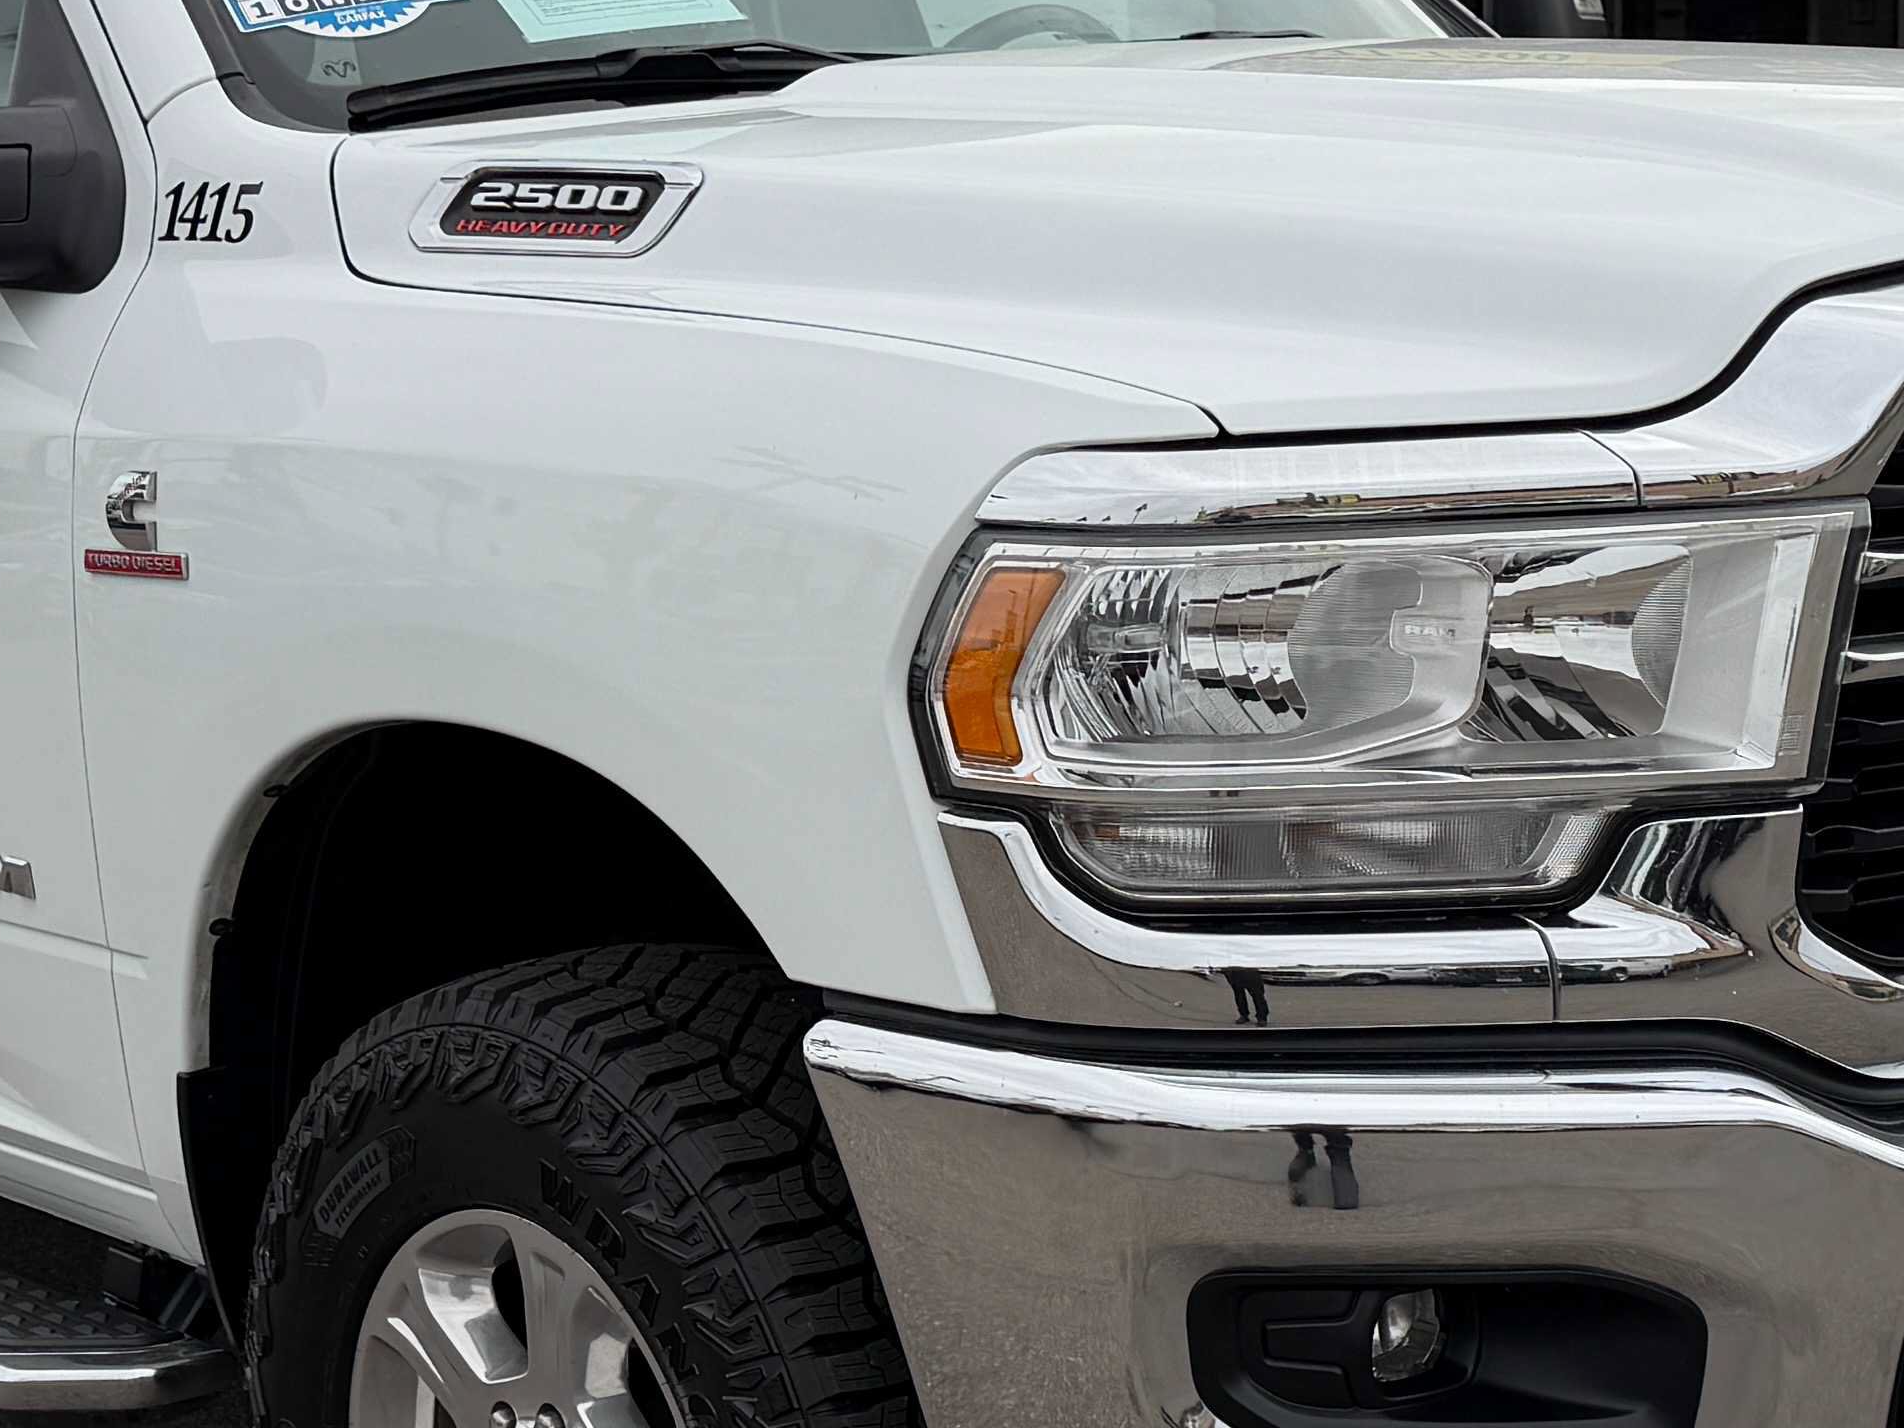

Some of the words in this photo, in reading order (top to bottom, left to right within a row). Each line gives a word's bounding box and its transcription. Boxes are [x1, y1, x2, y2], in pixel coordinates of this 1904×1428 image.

[335, 9, 387, 25] CARFAX
[470, 181, 645, 212] 2500
[157, 180, 264, 243] 1415
[455, 219, 547, 236] HEAVY
[546, 221, 626, 237] DUTY
[87, 553, 130, 568] TURBO
[131, 555, 181, 573] DIESEL
